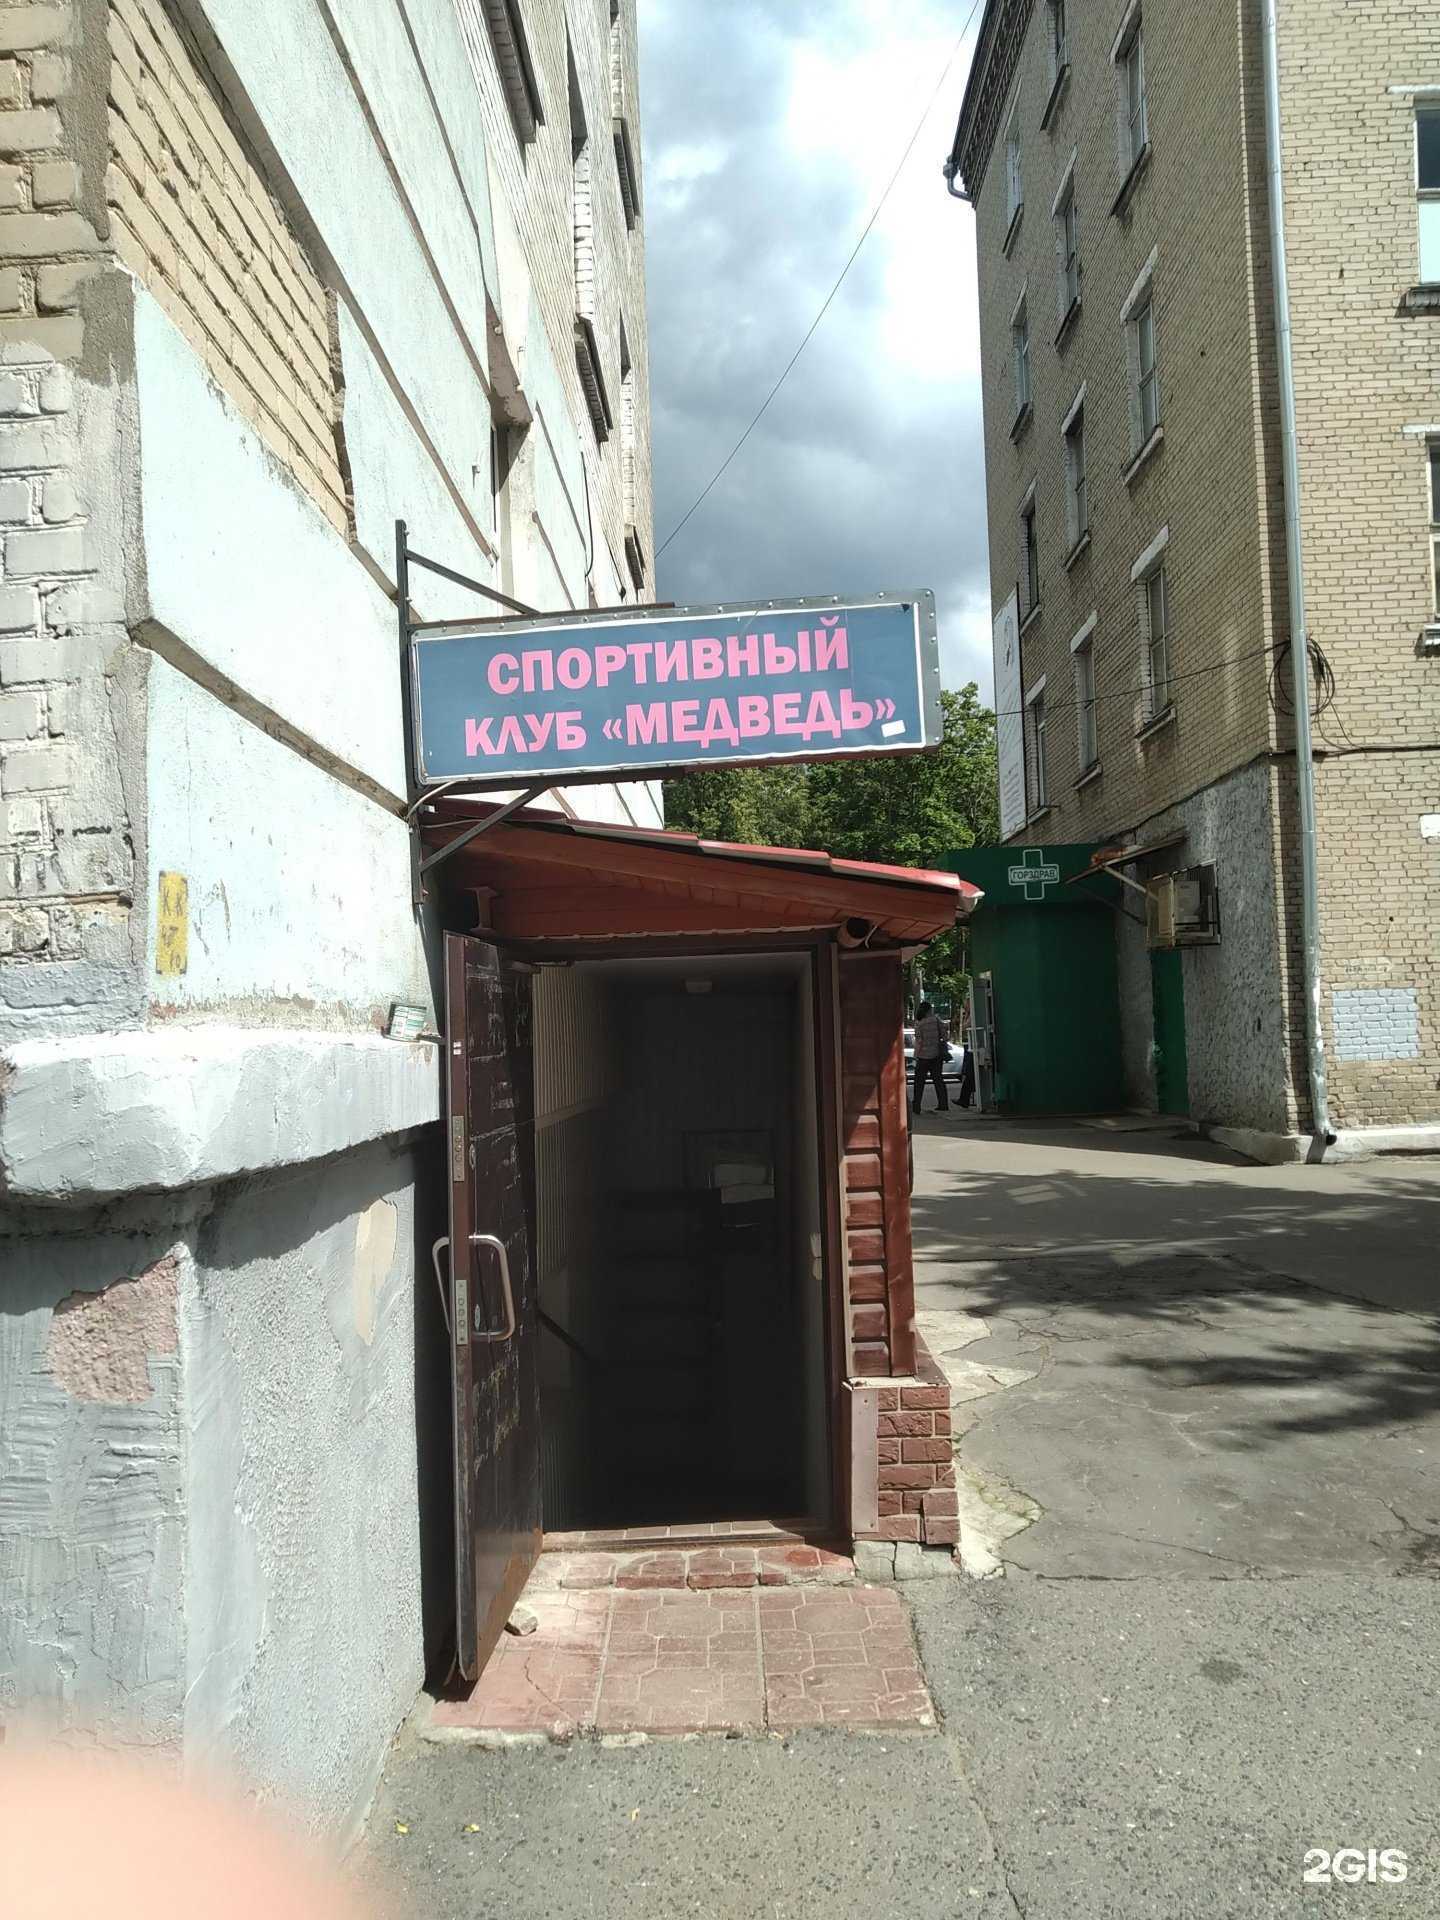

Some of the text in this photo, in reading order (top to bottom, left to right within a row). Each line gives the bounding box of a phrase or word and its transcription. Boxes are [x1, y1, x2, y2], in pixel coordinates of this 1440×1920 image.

[487, 616, 849, 694] СПОРТИВНЫЙ
[464, 689, 897, 757] КЛУБ «МЕДВЕДЬ»
[1013, 869, 1056, 880] ГОРЗДРАВ
